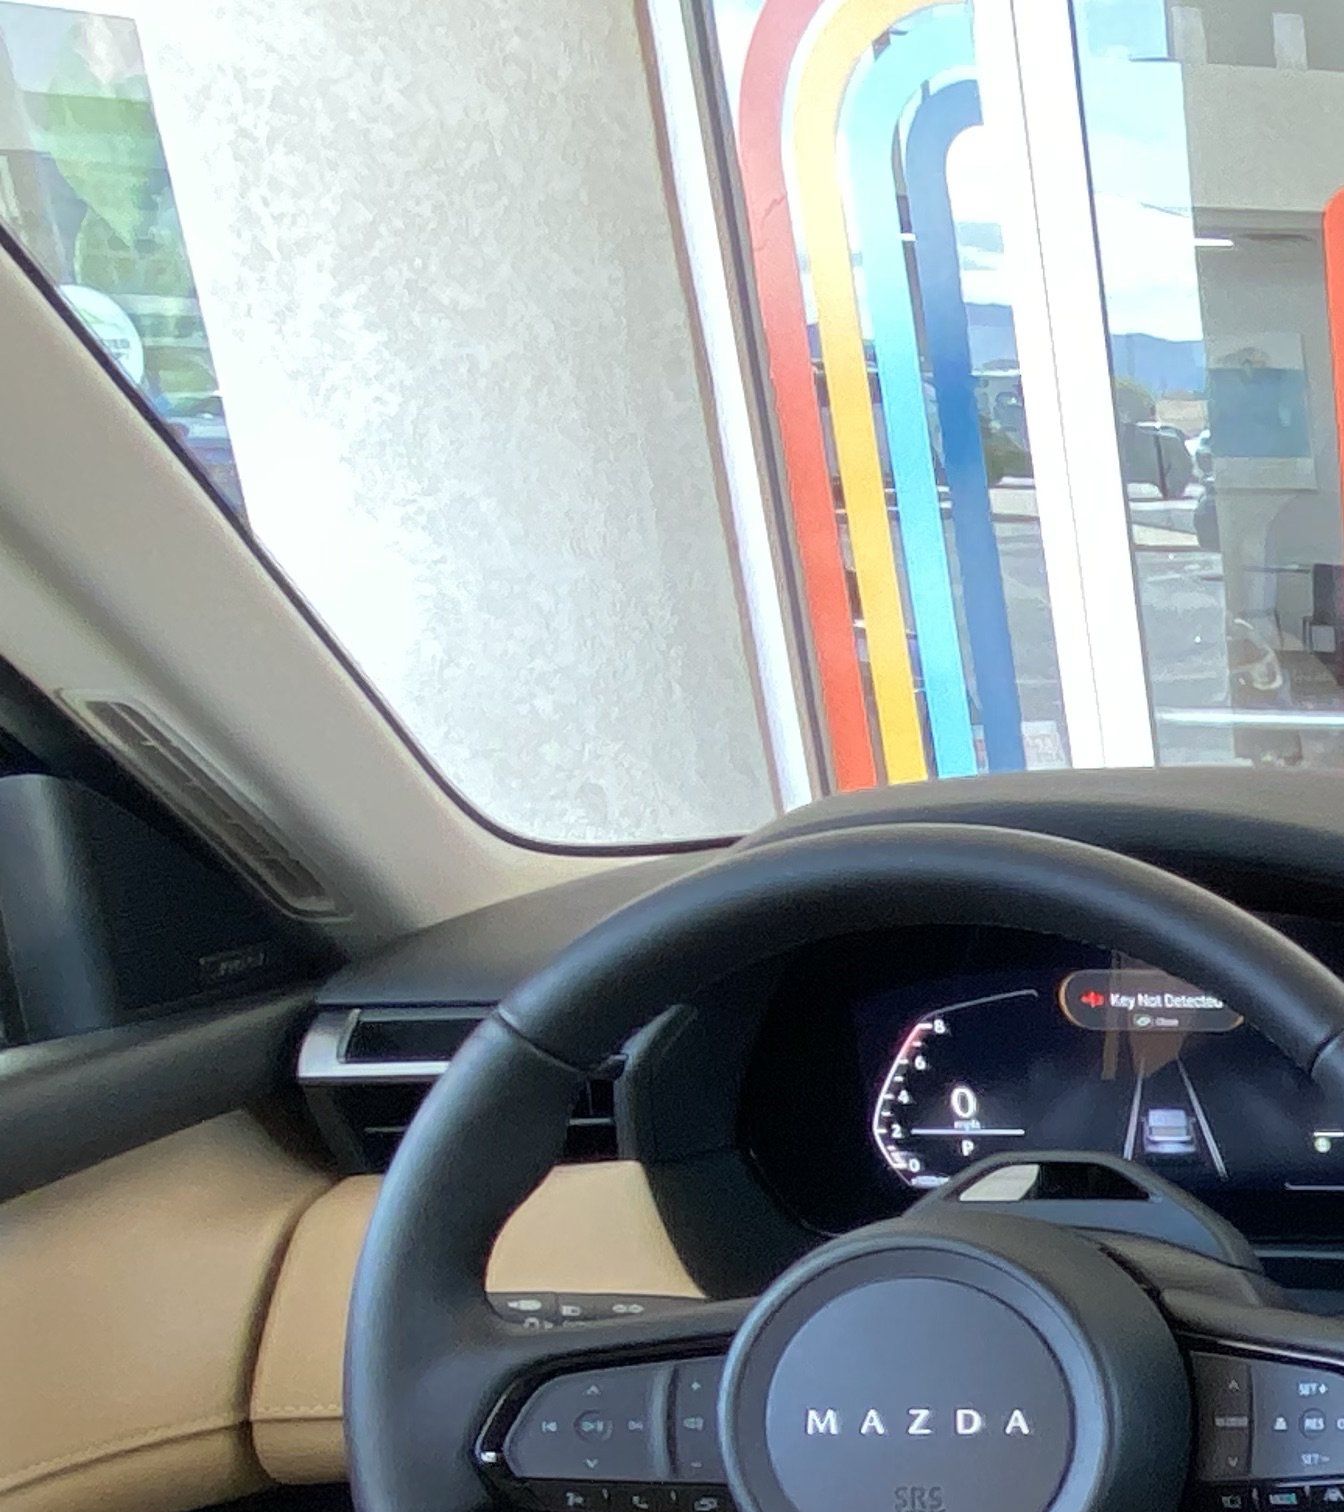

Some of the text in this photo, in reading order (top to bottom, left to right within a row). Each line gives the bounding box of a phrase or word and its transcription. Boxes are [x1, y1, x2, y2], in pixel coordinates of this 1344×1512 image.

[1109, 993, 1135, 1011] Key
[1137, 993, 1162, 1008] Not
[933, 1019, 946, 1034] 8
[914, 1056, 927, 1071] 6
[951, 1086, 978, 1119] 0
[891, 1124, 903, 1138] 2
[961, 1139, 975, 1157] P
[908, 1158, 921, 1172] 0
[807, 1408, 1032, 1436] MAZDA
[895, 1486, 942, 1509] SRS
